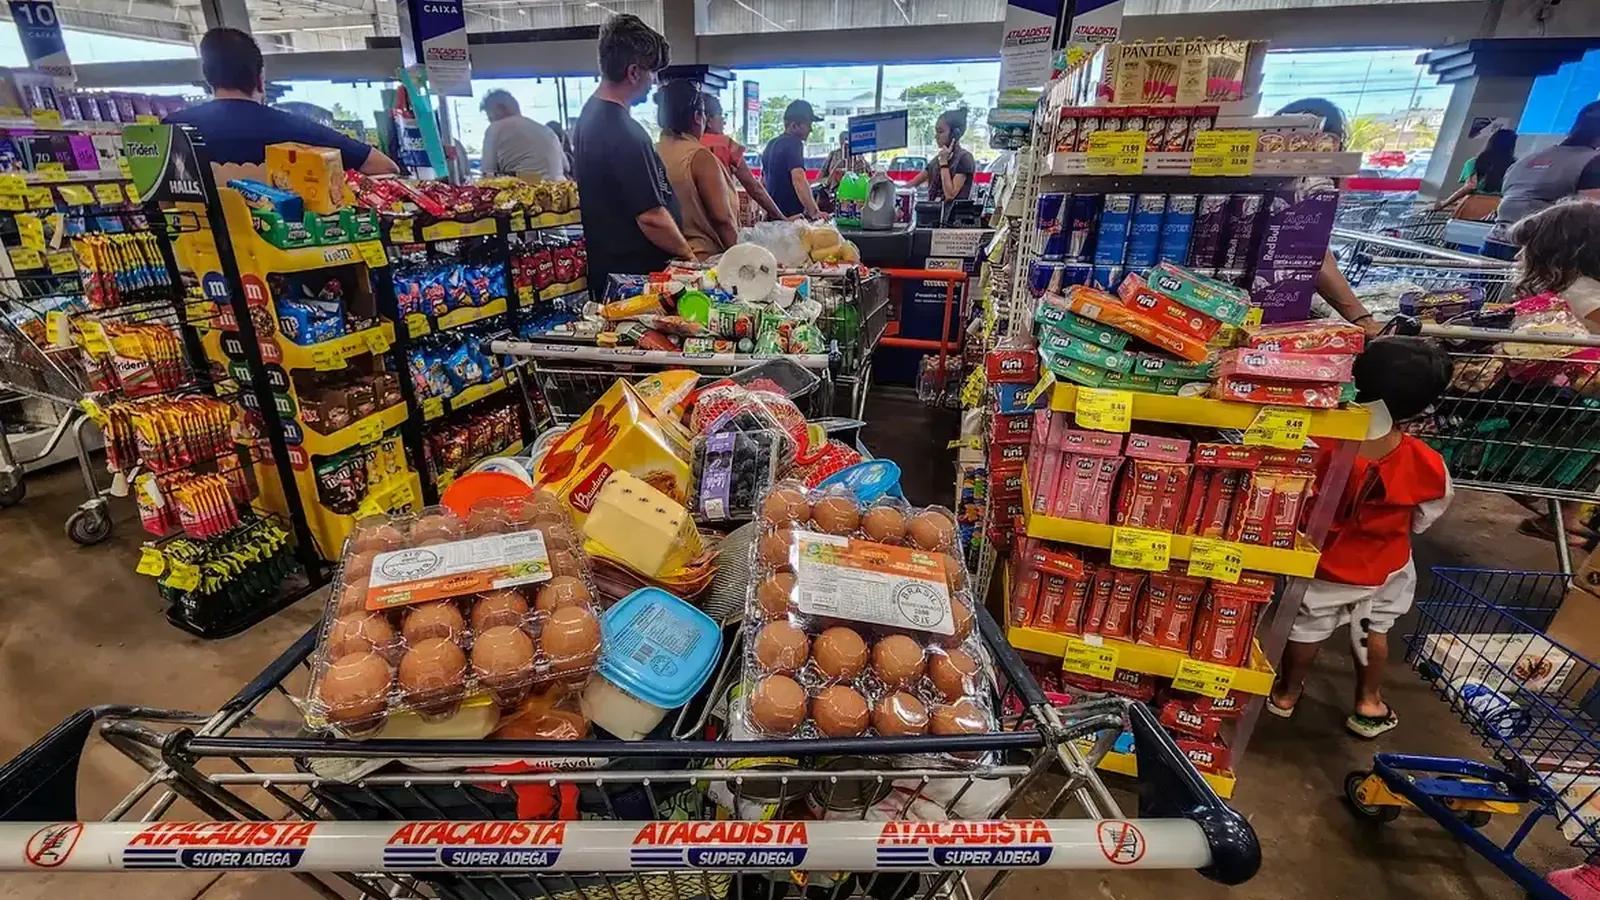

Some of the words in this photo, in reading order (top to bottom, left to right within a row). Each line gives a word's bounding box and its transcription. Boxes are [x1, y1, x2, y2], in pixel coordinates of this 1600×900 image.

[18, 2, 54, 26] 10
[424, 4, 458, 14] CAIXA
[1006, 26, 1052, 39] ATACADISTA
[1075, 26, 1118, 36] ATACADISTA
[1122, 45, 1182, 58] PANTENE
[1184, 43, 1245, 56] PANTENE
[126, 143, 158, 156] Trident
[170, 180, 200, 194] HALLS
[1268, 224, 1281, 243] Bull
[1263, 242, 1276, 261] Red
[208, 280, 227, 296] m
[246, 285, 262, 298] m
[1137, 294, 1157, 308] Fini
[1044, 308, 1064, 322] Fini
[226, 338, 243, 354] m
[1050, 334, 1070, 348] Fini
[1002, 358, 1022, 369] Fini
[1142, 359, 1164, 370] Fini
[275, 399, 290, 412] m
[1009, 420, 1028, 430] Fini
[1004, 446, 1022, 456] Fini
[1142, 473, 1160, 482] Fini
[1152, 542, 1167, 550] 8.99
[1225, 554, 1240, 564] 8.99
[902, 586, 938, 604] BRASIL
[913, 614, 931, 624] SIF
[1220, 608, 1237, 616] Fini
[1118, 670, 1139, 684] Fini
[1178, 710, 1202, 724] Fini
[1188, 750, 1212, 763] Fini
[127, 822, 316, 846] ATACADISTA
[386, 821, 565, 846] ATACADISTA
[630, 820, 808, 845] ATACADISTA
[878, 820, 1052, 844] ATACADISTA
[192, 852, 240, 867] SUPER
[243, 852, 291, 866] ADEGA
[451, 852, 500, 866] SUPER
[502, 852, 548, 866] ADEGA
[698, 852, 744, 866] SUPER
[747, 851, 794, 866] ADEGA
[944, 850, 990, 865] SUPER
[992, 850, 1040, 864] ADEGA
